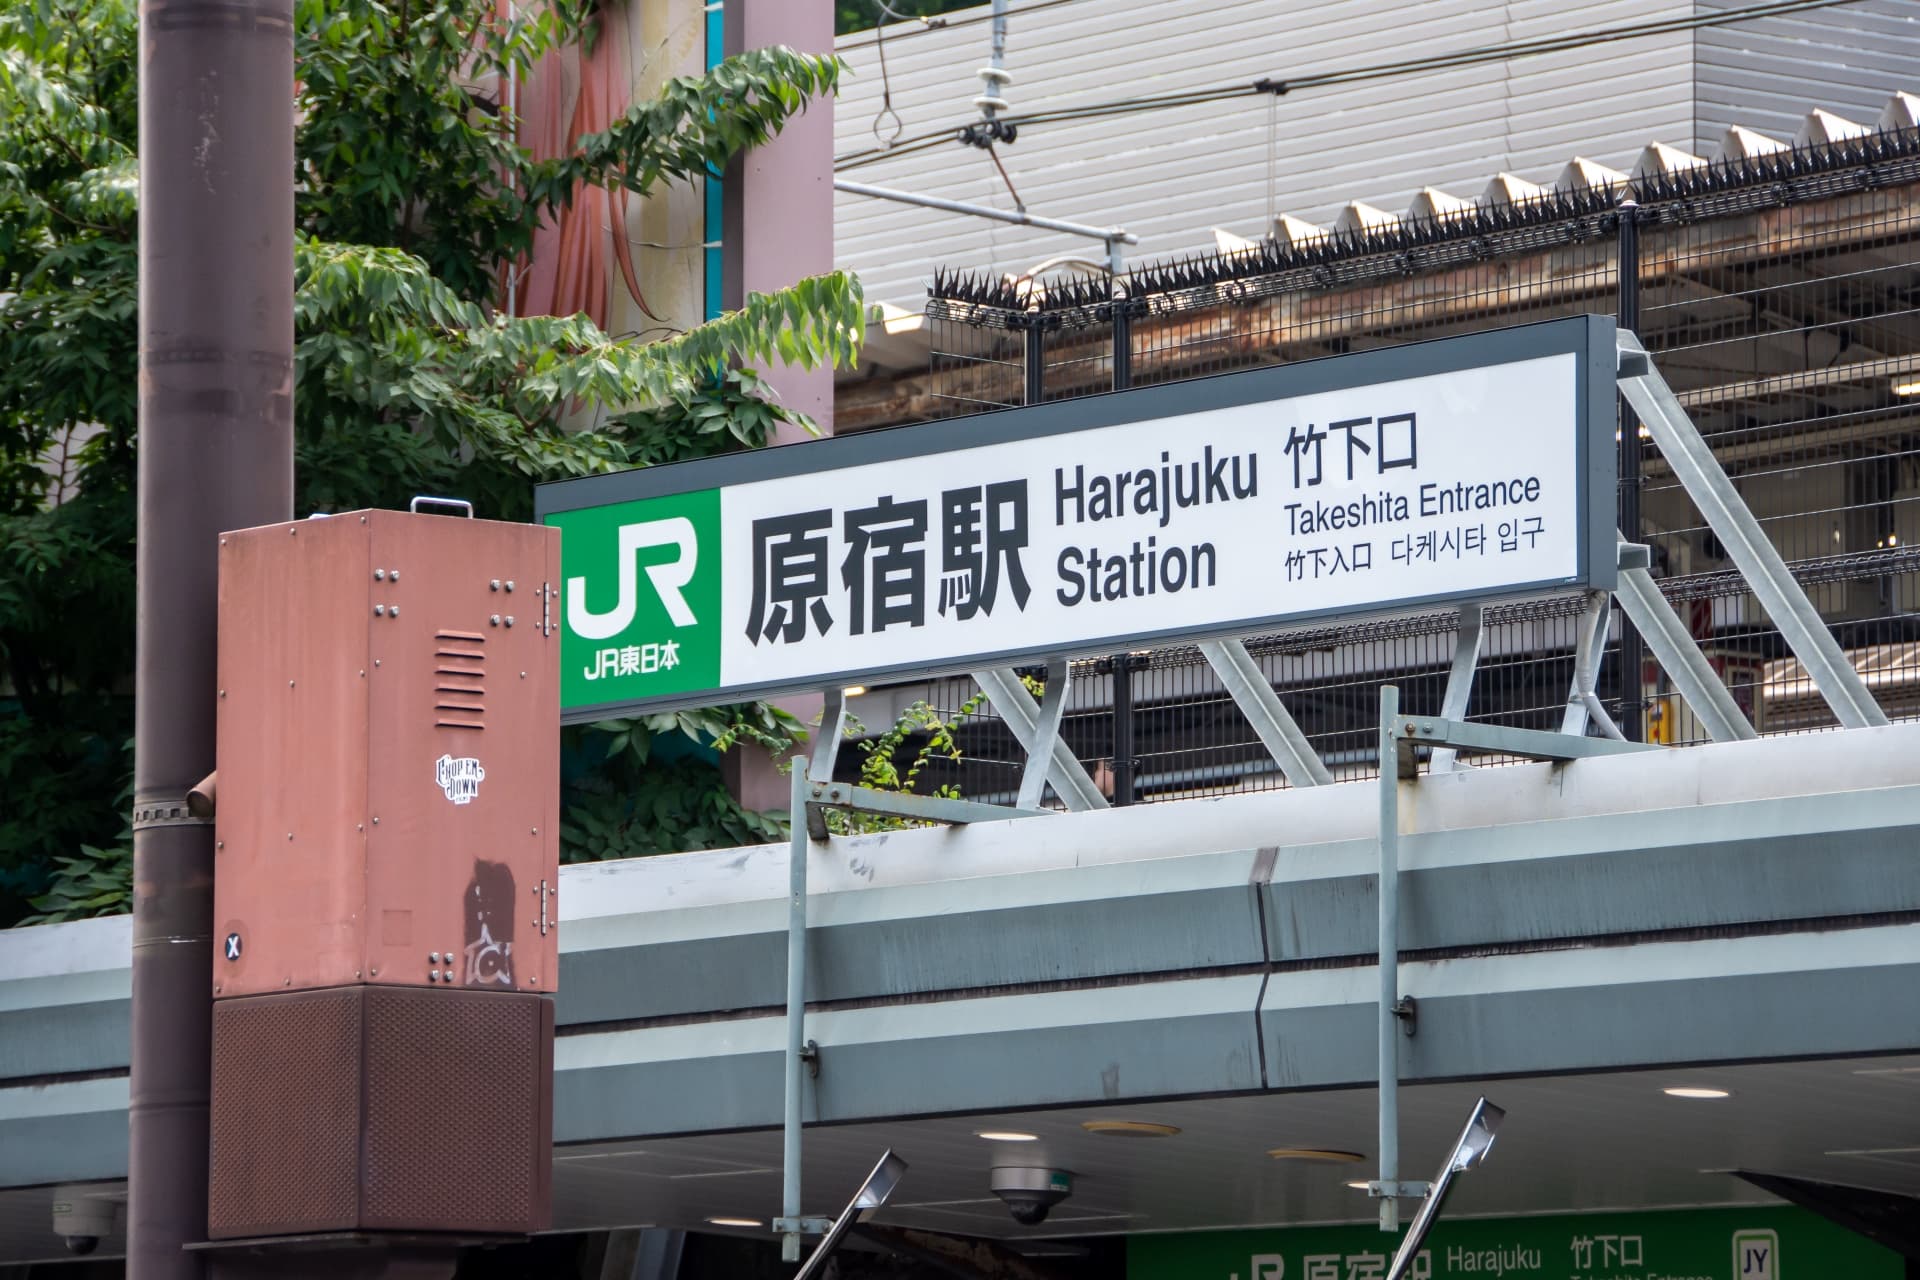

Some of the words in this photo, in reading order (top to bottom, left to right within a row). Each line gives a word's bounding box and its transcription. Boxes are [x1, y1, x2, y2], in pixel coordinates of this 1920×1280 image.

[1283, 412, 1418, 489] 竹下口
[1055, 445, 1258, 528] Harajuku
[1284, 491, 1410, 537] Takeshita
[1420, 476, 1541, 518] Entrance
[744, 478, 1032, 647] 原宿駅
[1284, 542, 1373, 582] 竹下入口
[1391, 522, 1487, 566] 다케시타
[1497, 516, 1545, 553] 입구
[567, 516, 698, 640] JR
[1056, 535, 1217, 607] Station
[583, 639, 681, 681] JR東日本
[447, 778, 477, 799] DOWN
[1447, 1244, 1542, 1278] Harajuku
[1570, 1235, 1643, 1269] 竹下口
[1744, 1248, 1769, 1274] JY
